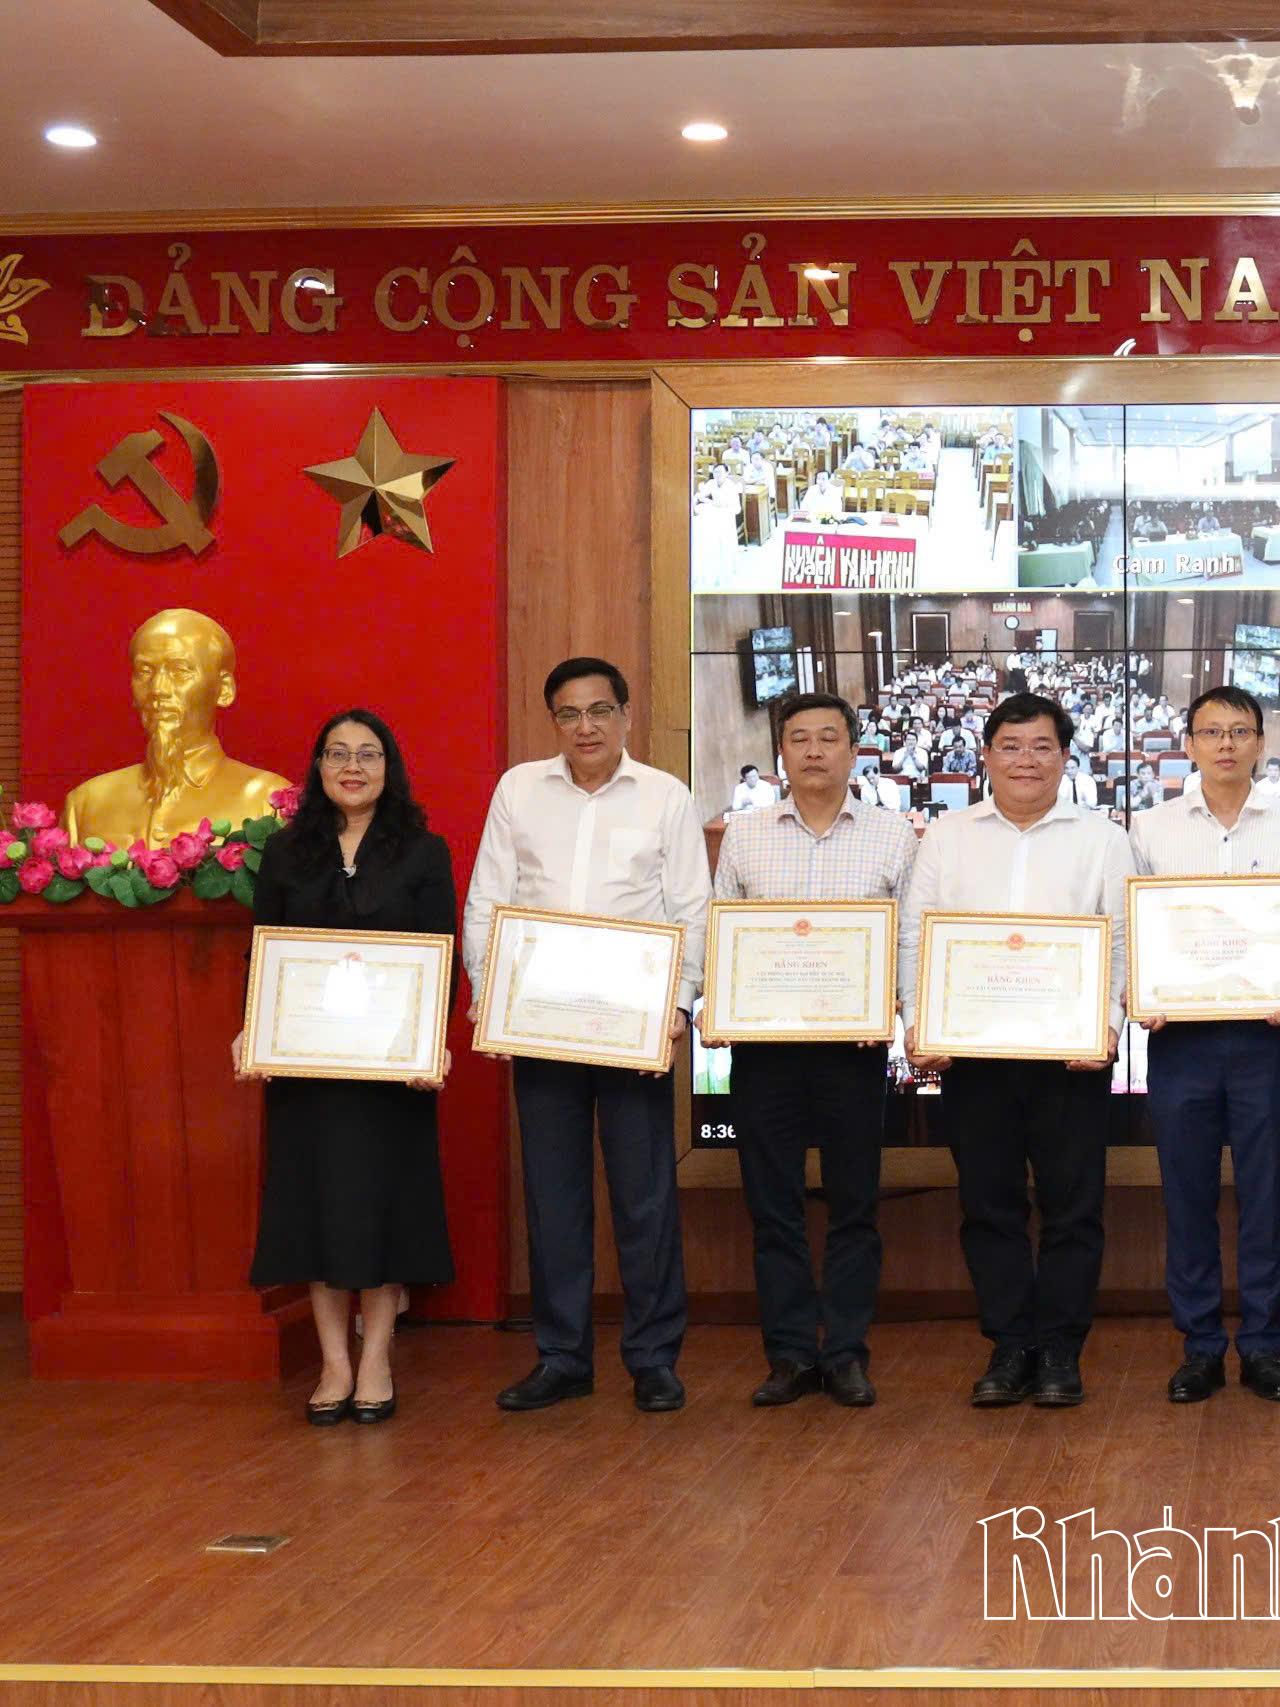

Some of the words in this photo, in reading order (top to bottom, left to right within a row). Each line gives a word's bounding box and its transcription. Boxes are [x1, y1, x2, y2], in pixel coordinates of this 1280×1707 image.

[81, 242, 344, 338] ĐẢNG
[375, 246, 639, 348] CỘNG
[667, 232, 857, 328] SẢN
[888, 238, 1111, 343] VIỆT
[1113, 553, 1166, 574] Cam
[1175, 552, 1235, 574] Ranh
